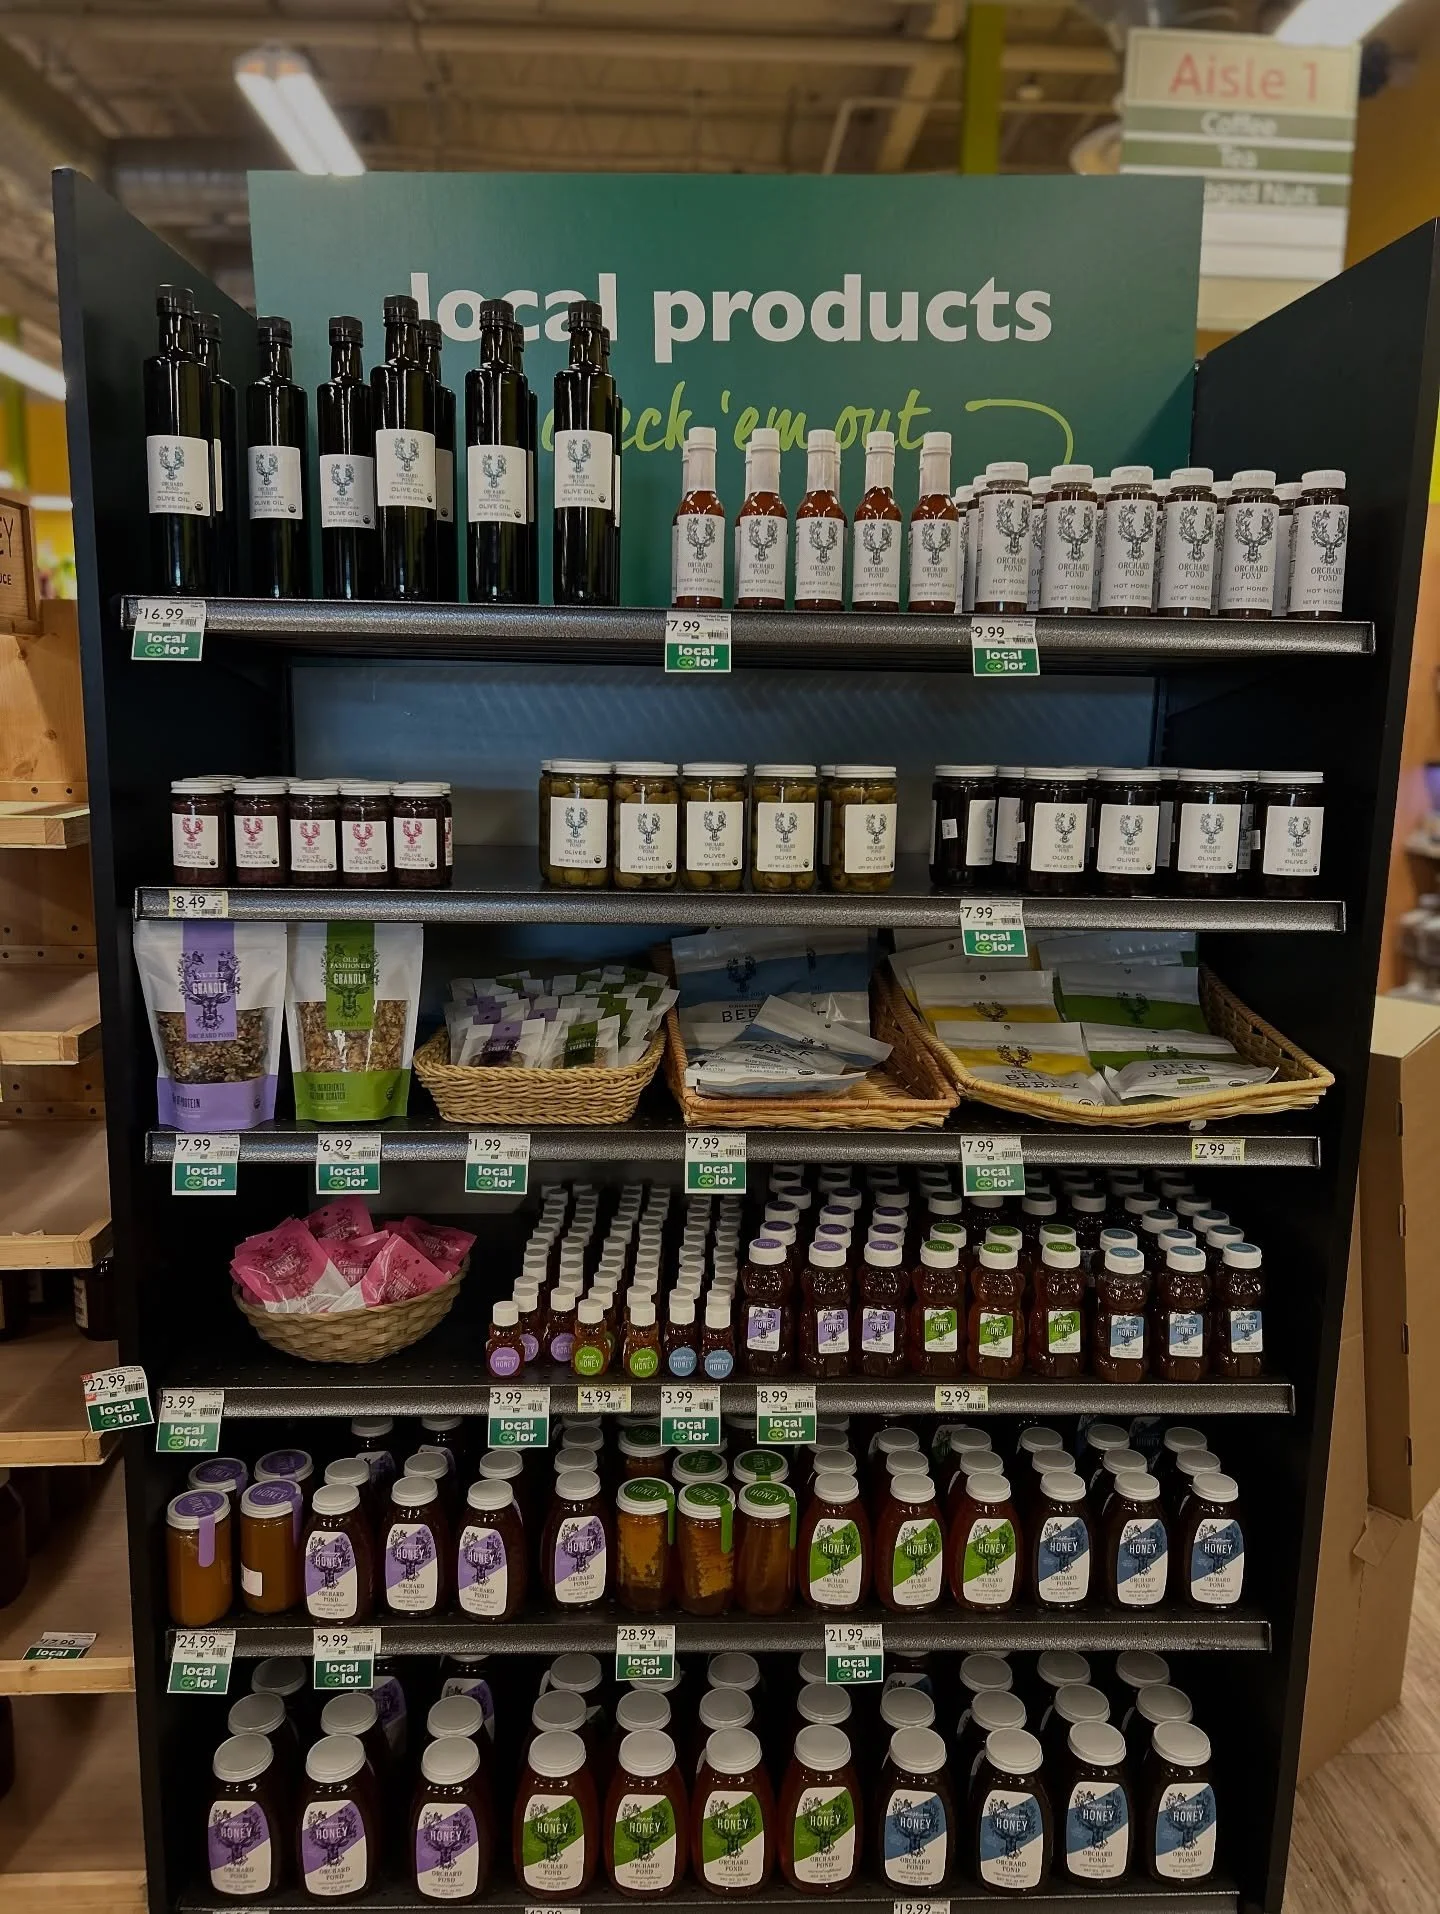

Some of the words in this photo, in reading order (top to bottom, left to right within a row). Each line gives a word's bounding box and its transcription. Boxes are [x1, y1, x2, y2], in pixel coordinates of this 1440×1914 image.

[1169, 53, 1286, 101] Aisle
[1304, 62, 1319, 102] 1
[1201, 112, 1278, 138] Coffee
[1217, 143, 1258, 169] Tea
[1261, 182, 1319, 206] Nuts
[410, 272, 618, 342] local
[654, 273, 1053, 363] products
[721, 390, 808, 451] 'em
[834, 389, 931, 450] out
[1065, 570, 1084, 578] POND
[1125, 569, 1144, 577] POND
[138, 608, 184, 620] $16.99
[147, 633, 186, 643] local
[678, 645, 714, 655] local
[986, 650, 1022, 659] local
[173, 896, 206, 909] $8.49
[960, 907, 992, 919] $7.99
[975, 932, 1010, 941] local
[333, 974, 367, 985] GRANOLA
[192, 982, 228, 995] GRANOLA
[177, 1138, 211, 1151] $7.99
[319, 1139, 352, 1152] $6.99
[687, 1137, 719, 1149] $7.99
[962, 1141, 993, 1153] $7.99
[1194, 1143, 1225, 1156] $7.99
[186, 1165, 222, 1176] local
[329, 1165, 365, 1176] local
[478, 1165, 512, 1177] local
[699, 1164, 733, 1174] local
[976, 1165, 1010, 1177] local
[930, 1323, 952, 1331] HONEY
[985, 1327, 1007, 1336] HONEY
[1054, 1324, 1075, 1332] HONEY
[1176, 1327, 1196, 1335] HONEY
[495, 1360, 517, 1368] HONEY
[579, 1360, 600, 1368] HONEY
[634, 1361, 655, 1370] HONEY
[709, 1363, 729, 1371] HONEY
[84, 1374, 126, 1392] $22.99
[490, 1391, 522, 1405] $3.99
[581, 1391, 611, 1403] $4.99
[662, 1391, 692, 1404] $3.99
[757, 1391, 788, 1403] $8.99
[941, 1390, 970, 1402] $9.99
[163, 1395, 195, 1409] $3.99
[99, 1401, 135, 1416] local
[500, 1420, 534, 1430] local
[672, 1419, 705, 1430] local
[769, 1418, 803, 1428] local
[170, 1425, 205, 1435] local
[630, 1485, 662, 1498] HONEY
[692, 1488, 719, 1502] HONEY
[751, 1489, 781, 1501] HONEY
[567, 1540, 595, 1552] HONEY
[822, 1544, 850, 1554] HONEY
[906, 1544, 933, 1555] HONEY
[978, 1544, 1006, 1553] HONEY
[1050, 1542, 1078, 1552] HONEY
[1130, 1544, 1157, 1554] HONEY
[1204, 1544, 1232, 1554] HONEY
[396, 1550, 424, 1560] HONEY
[468, 1551, 495, 1564] HONEY
[315, 1555, 343, 1567] HONEY
[617, 1628, 656, 1641] $28.99
[826, 1628, 863, 1642] $21.99
[177, 1635, 215, 1648] $24.99
[317, 1635, 348, 1647] $9.99
[36, 1649, 69, 1657] local
[627, 1656, 660, 1666] local
[837, 1657, 869, 1667] local
[182, 1665, 216, 1676] local
[326, 1662, 359, 1673] local
[1083, 1809, 1114, 1820] HONEY
[1173, 1810, 1203, 1821] HONEY
[717, 1819, 748, 1830] HONEY
[810, 1815, 840, 1826] HONEY
[900, 1818, 931, 1830] HONEY
[996, 1819, 1028, 1831] HONEY
[220, 1827, 252, 1838] HONEY
[315, 1827, 348, 1839] HONEY
[537, 1823, 568, 1834] HONEY
[629, 1822, 660, 1833] HONEY
[430, 1830, 462, 1841] HONEY
